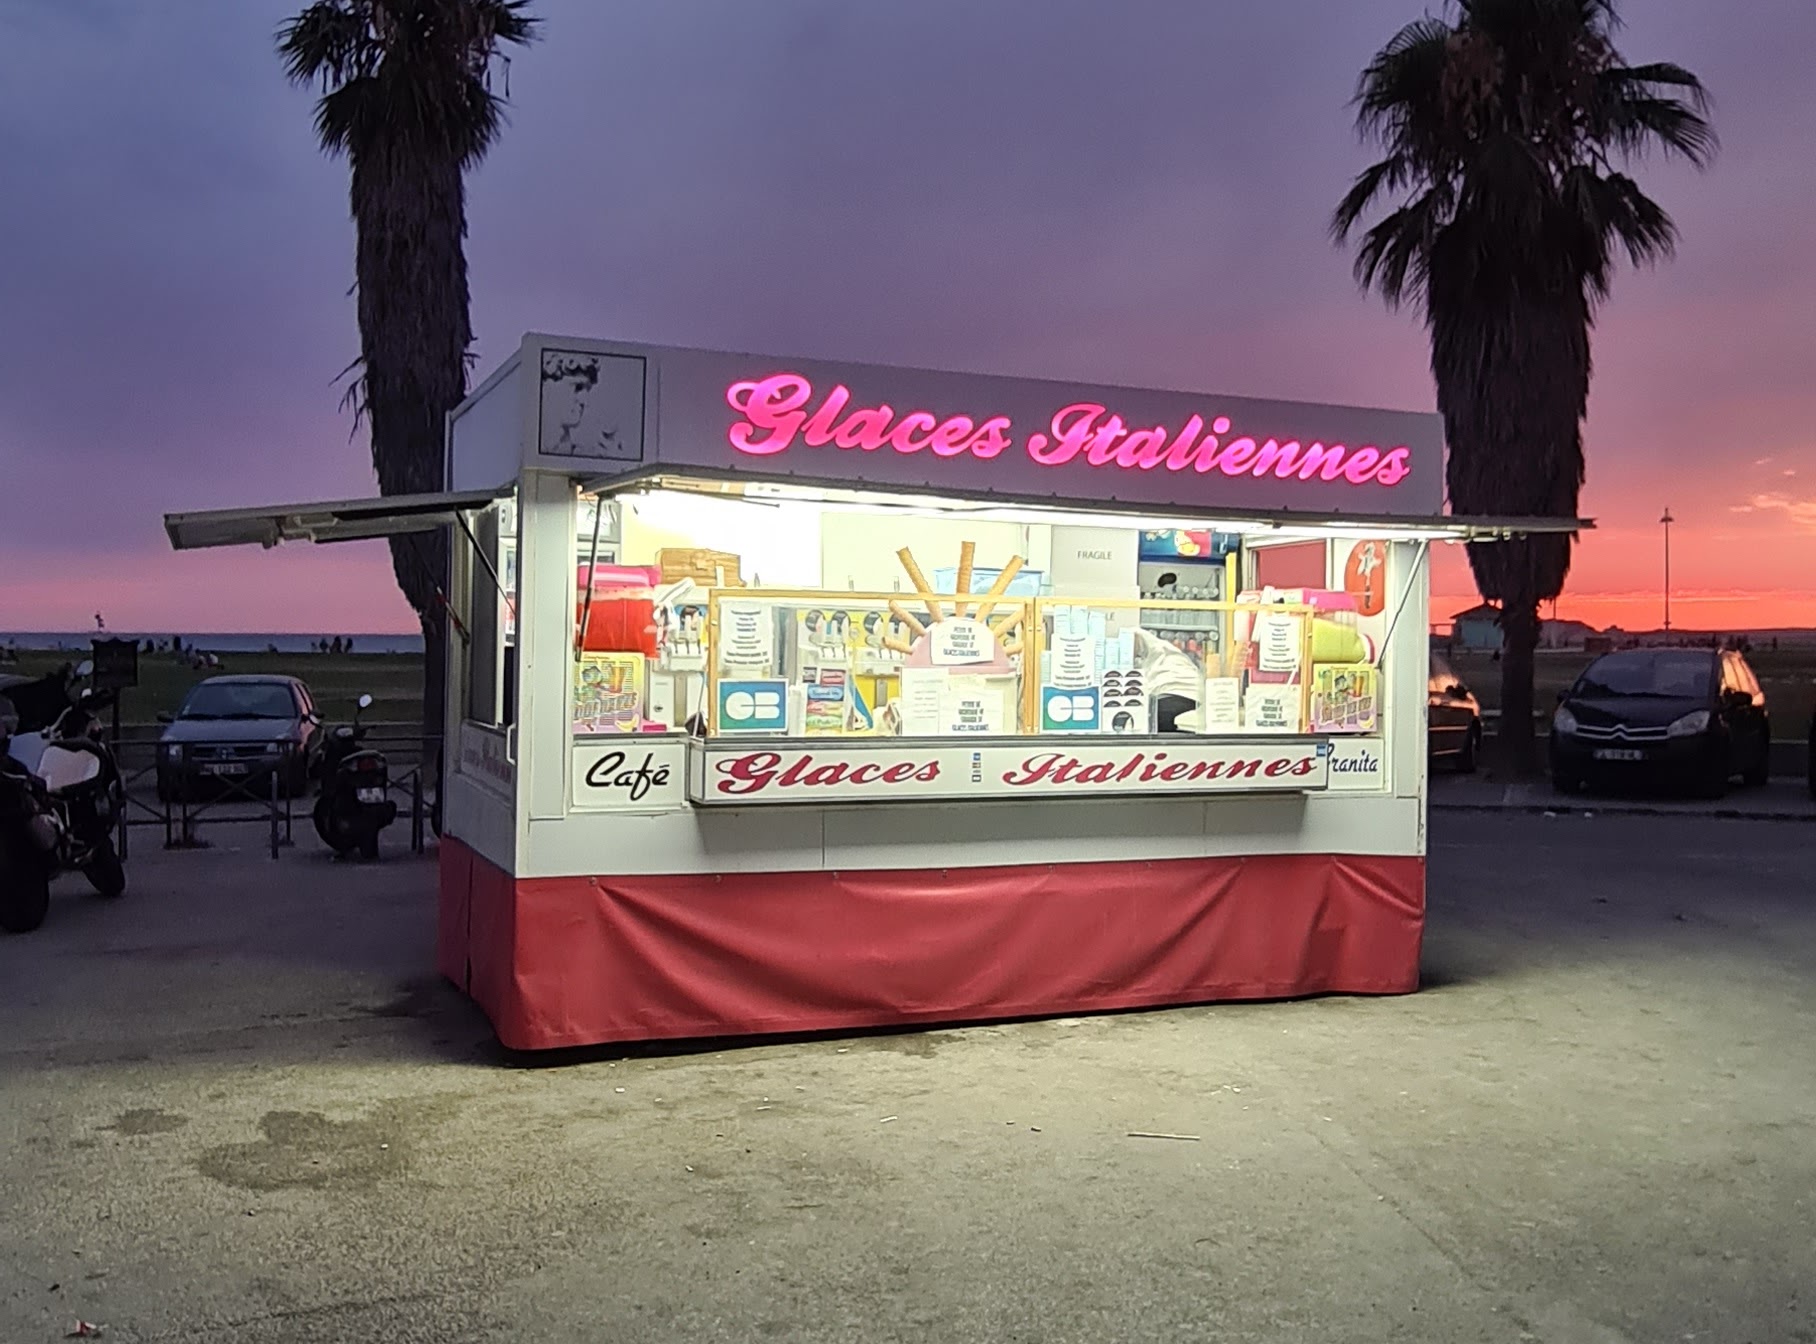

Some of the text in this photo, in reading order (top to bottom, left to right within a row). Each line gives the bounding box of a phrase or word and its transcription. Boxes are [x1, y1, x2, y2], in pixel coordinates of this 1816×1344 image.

[726, 373, 1410, 486] Glaces Italiennes
[1077, 550, 1112, 560] FRAGILE
[725, 690, 780, 721] CB
[1047, 695, 1095, 722] CB
[585, 751, 670, 801] Café
[715, 752, 1317, 794] Glaces Italiennes
